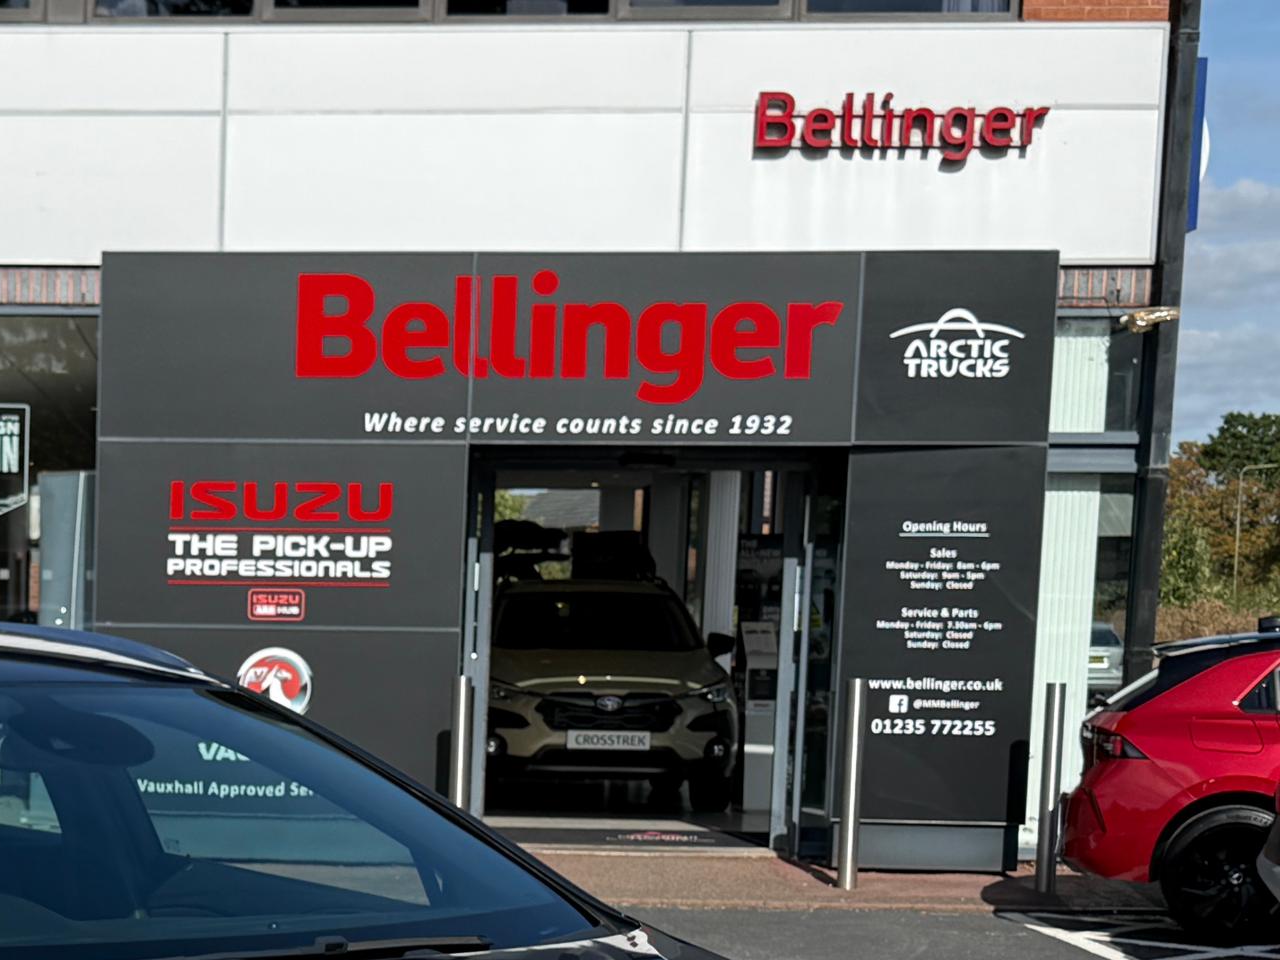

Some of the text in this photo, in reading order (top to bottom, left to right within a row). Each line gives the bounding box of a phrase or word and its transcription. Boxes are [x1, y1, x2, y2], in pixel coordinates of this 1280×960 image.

[755, 91, 1050, 161] Bellinger
[295, 269, 844, 405] Bellinger
[904, 339, 1010, 358] ARCTIC
[903, 358, 1010, 378] TRUCKS
[363, 411, 793, 435] Where service counts since 1932
[170, 480, 394, 522] ISUZU
[902, 520, 987, 534] Opening Hours
[167, 533, 393, 558] THE PICK-UP
[929, 547, 958, 558] Sales
[166, 558, 392, 578] PROFESSIONALS
[885, 561, 920, 570] Monday
[925, 561, 953, 570] Friday:
[981, 561, 1001, 571] 6pm
[900, 571, 938, 580] Saturday:
[910, 581, 974, 591] Sunday: Closed
[252, 593, 300, 605] ISUZU
[901, 607, 979, 618] Service & Parts
[876, 620, 910, 630] Monday
[915, 620, 944, 630] Friday:
[983, 621, 1003, 631] 6pm
[904, 631, 973, 640] Saturday: Closed
[906, 640, 970, 650] Sunday: Closed
[868, 677, 1003, 692] www.bellinger.co.uk
[912, 699, 980, 711] @MMBellinger
[871, 718, 996, 736] 01235 772255
[574, 734, 647, 747] CROSSTREK
[137, 778, 204, 795] Vauxhall
[207, 781, 286, 798] Approved
